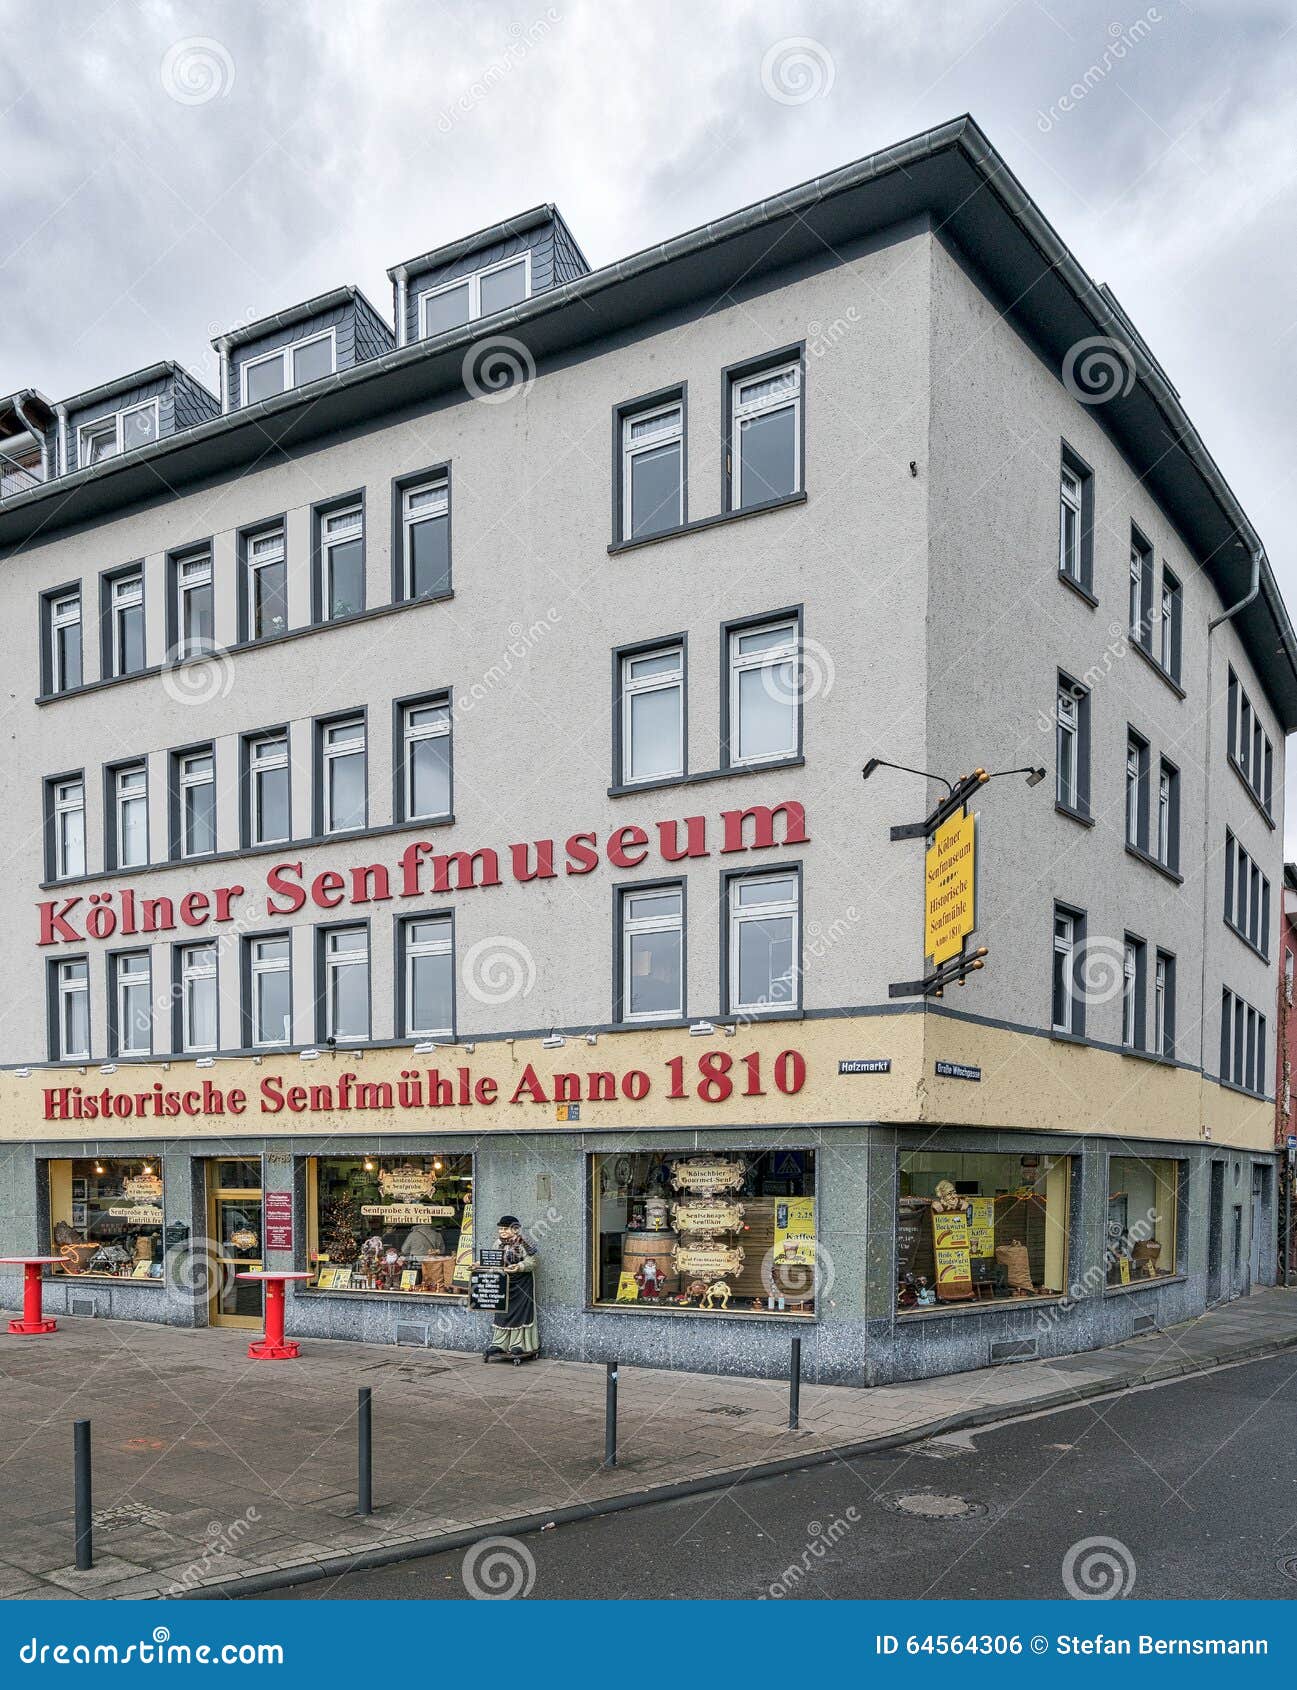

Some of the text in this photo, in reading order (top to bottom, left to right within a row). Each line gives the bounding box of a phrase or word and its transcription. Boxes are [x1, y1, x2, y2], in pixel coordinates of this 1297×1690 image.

[937, 828, 961, 857] Kölner
[35, 800, 811, 946] Kölner Senfmuseum
[928, 841, 972, 884] Senfmuseum
[930, 878, 968, 914] Historische
[930, 901, 967, 934] Senfmühle
[841, 1061, 888, 1072] Holzmarkt
[43, 1049, 807, 1121] Historische Senfmühle Anno 1810
[363, 1206, 402, 1216] Senfprobe
[385, 1215, 430, 1224] Eintritt frei
[786, 1232, 816, 1241] Kaffee
